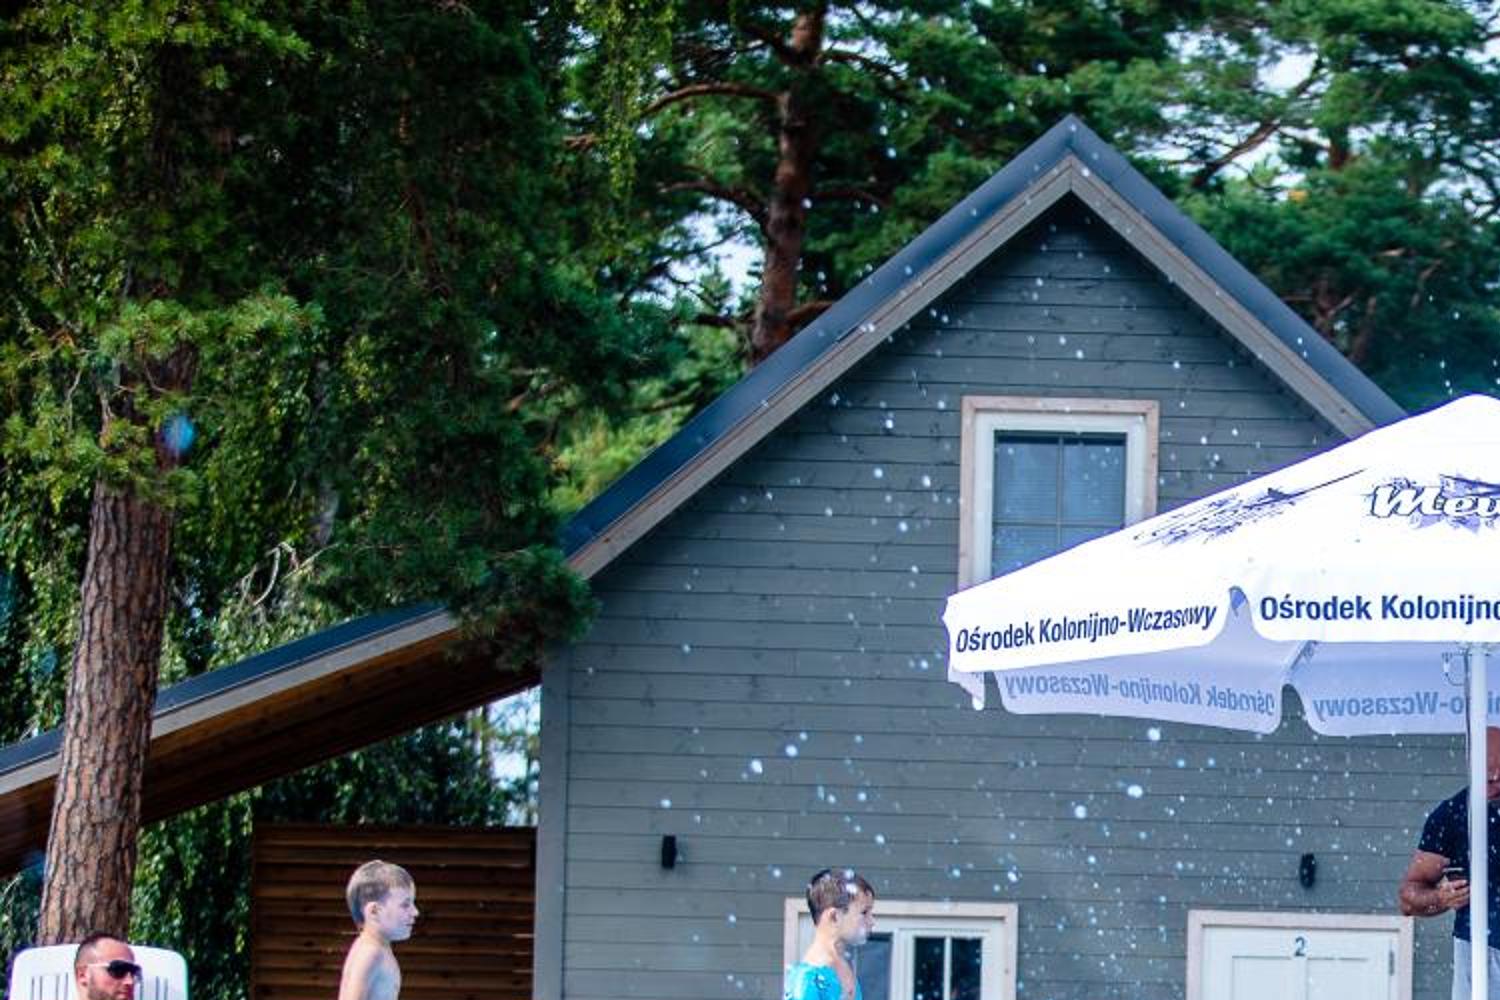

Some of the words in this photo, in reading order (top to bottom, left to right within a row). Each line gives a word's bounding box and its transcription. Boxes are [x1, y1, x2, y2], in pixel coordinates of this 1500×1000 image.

[1260, 593, 1373, 621] Ośrodek
[955, 620, 1035, 653] Ośrodek
[1038, 603, 1218, 644] Kolonijno-Wczasowy
[1295, 936, 1306, 958] 2
